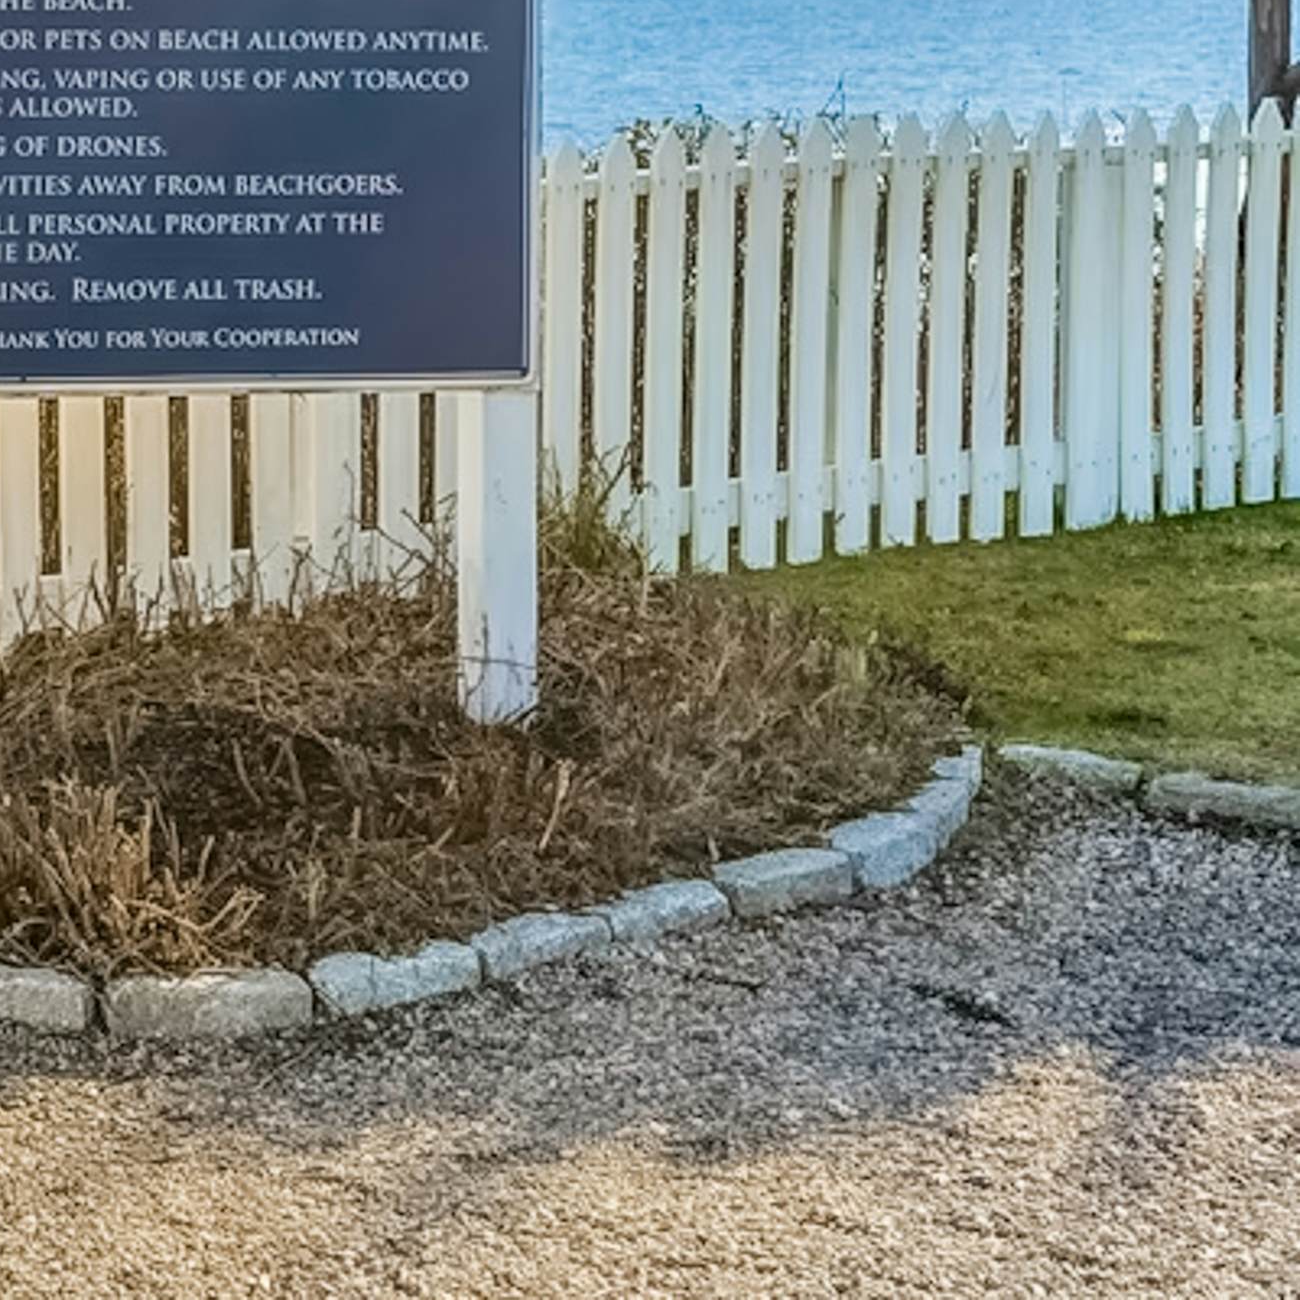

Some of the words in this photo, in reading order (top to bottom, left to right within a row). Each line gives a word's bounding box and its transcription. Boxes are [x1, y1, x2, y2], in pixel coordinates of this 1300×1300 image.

[44, 29, 102, 51] PETS
[109, 29, 150, 51] ON
[158, 29, 239, 51] BEACH
[246, 29, 368, 51] ALLOWED
[372, 31, 489, 53] ANYTIME.
[53, 68, 150, 91] VAPING
[155, 69, 195, 91] OR
[200, 68, 246, 91] USE
[252, 68, 287, 91] OF
[292, 70, 345, 90] ANY
[350, 68, 470, 92] TOBACCO
[8, 96, 138, 118] ALLOWED.
[13, 135, 49, 157] OF
[57, 135, 167, 157] DRONES.
[77, 174, 147, 196] AWAY
[154, 174, 226, 196] FROM
[235, 173, 404, 196] BEACHGOERS.
[28, 213, 157, 235] PERSONAL
[165, 213, 291, 235] PROPERTY
[295, 212, 327, 234] AT
[331, 212, 384, 234] THE
[27, 242, 81, 262] DAY.
[182, 279, 228, 300] ALL
[233, 278, 322, 300] TRASH.
[106, 330, 147, 349] FOR
